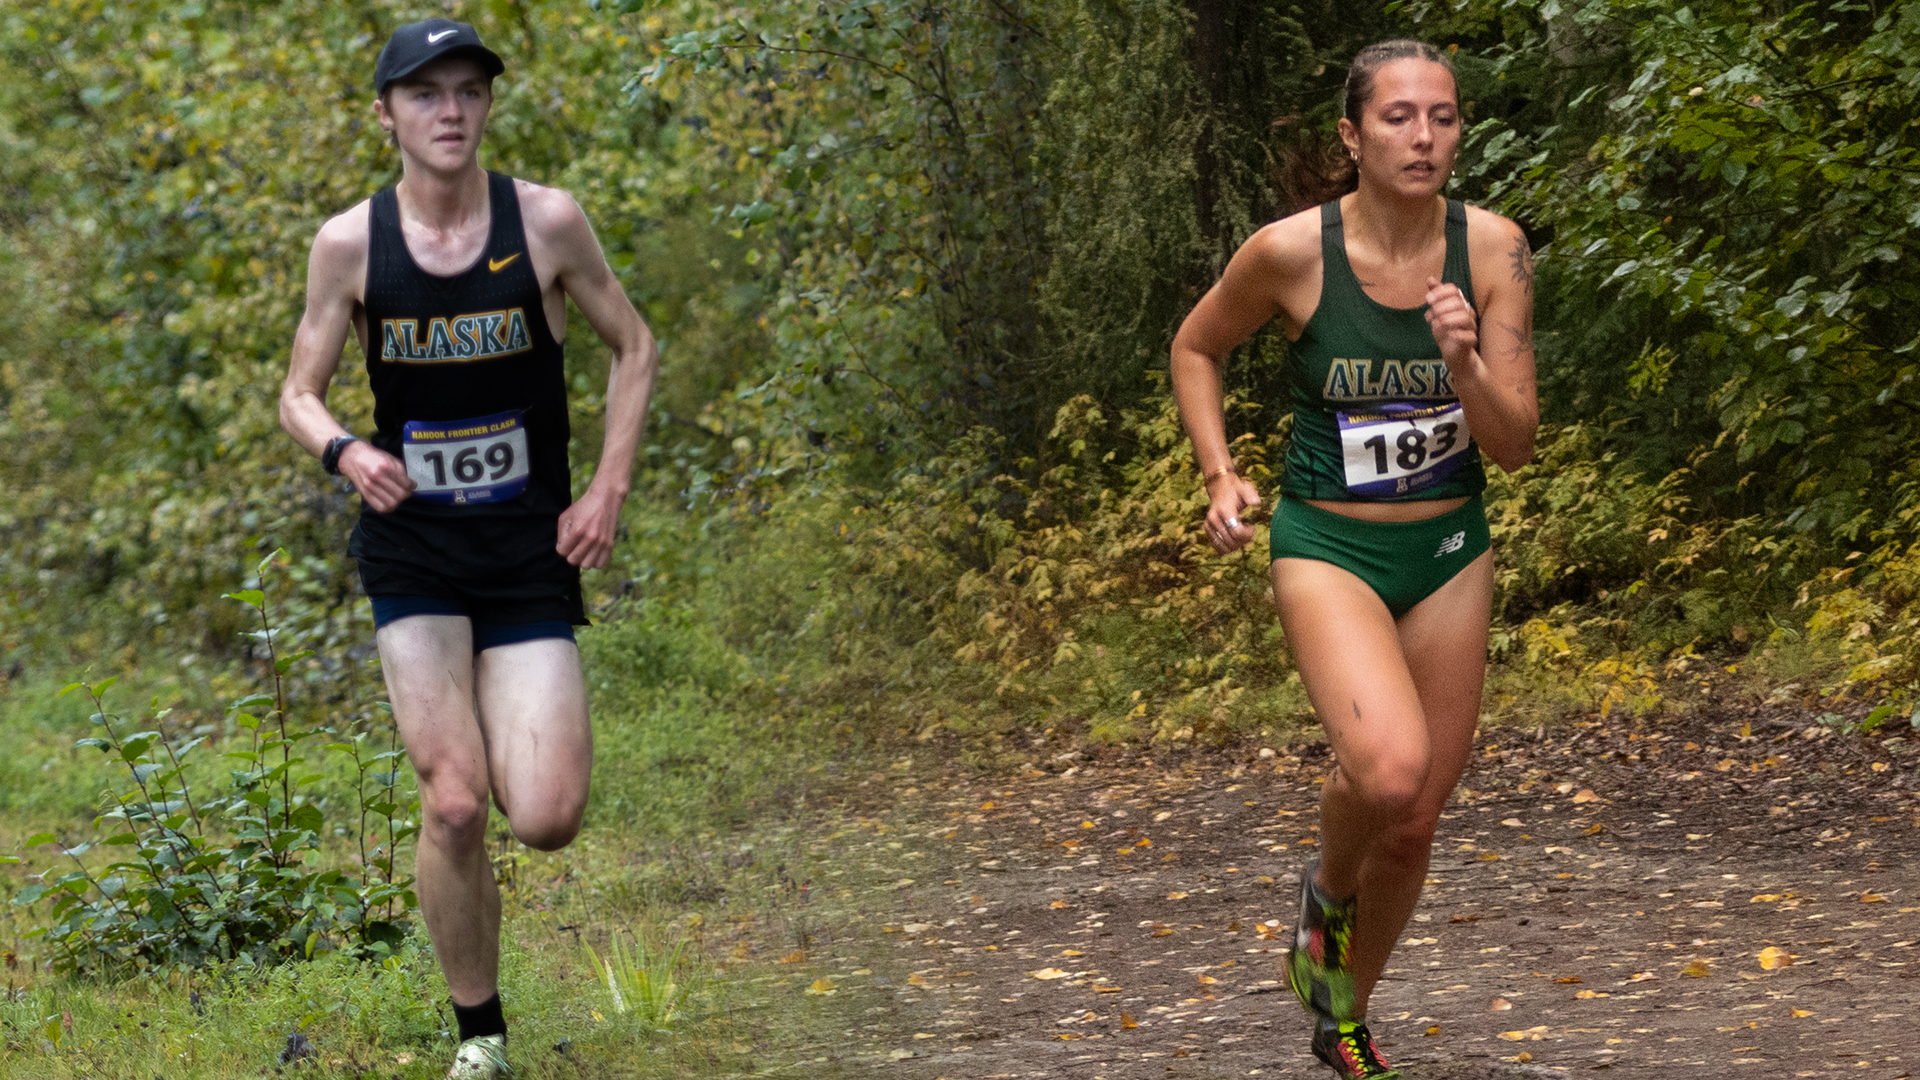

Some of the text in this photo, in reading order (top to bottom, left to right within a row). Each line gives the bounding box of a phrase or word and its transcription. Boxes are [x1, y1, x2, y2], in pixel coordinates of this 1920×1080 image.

[382, 308, 532, 362] ALASKA
[1323, 358, 1459, 400] ALASK
[412, 418, 516, 440] NANOOK FRONTIER CLASH
[1364, 422, 1458, 475] 183
[423, 442, 514, 486] 169
